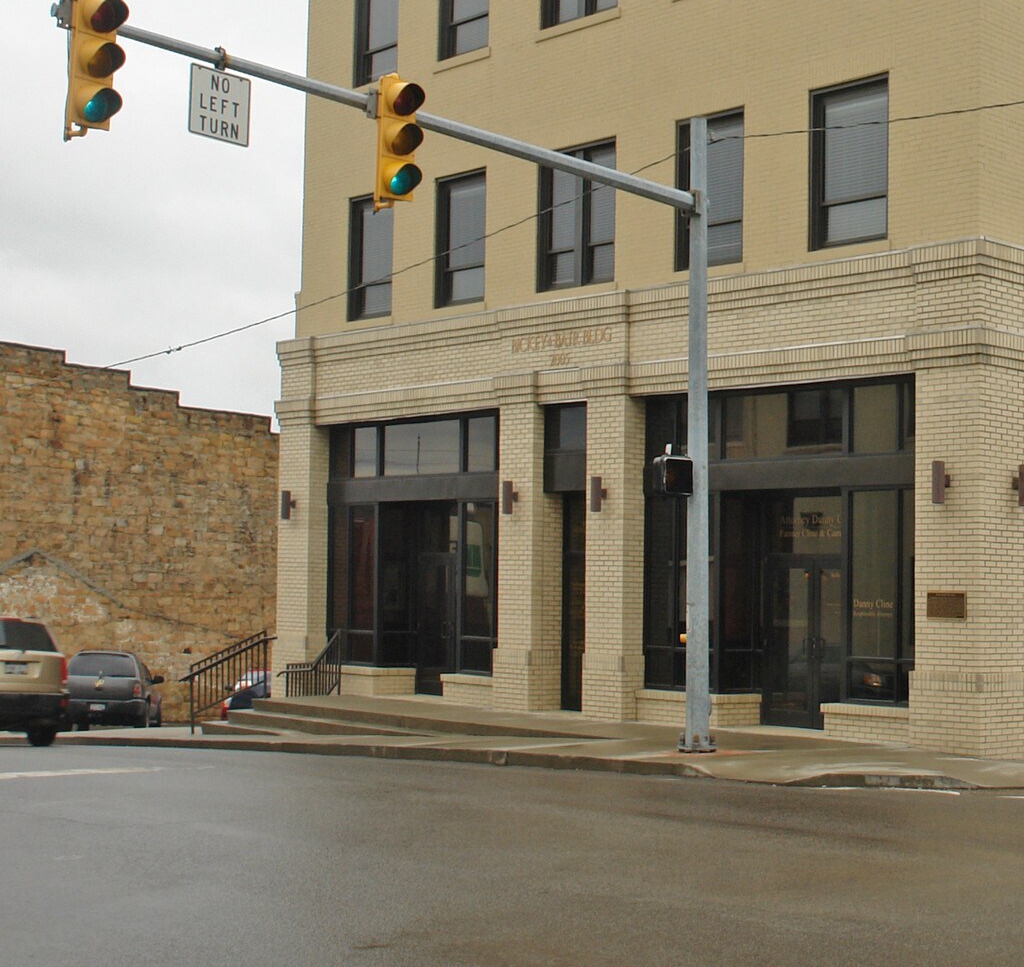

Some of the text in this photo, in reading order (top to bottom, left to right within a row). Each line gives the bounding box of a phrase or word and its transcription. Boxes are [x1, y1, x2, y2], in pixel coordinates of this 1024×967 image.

[211, 74, 230, 94] NO
[200, 93, 240, 118] LEFT
[200, 115, 239, 140] TURN
[853, 599, 875, 610] Danny
[875, 599, 894, 609] Cline
